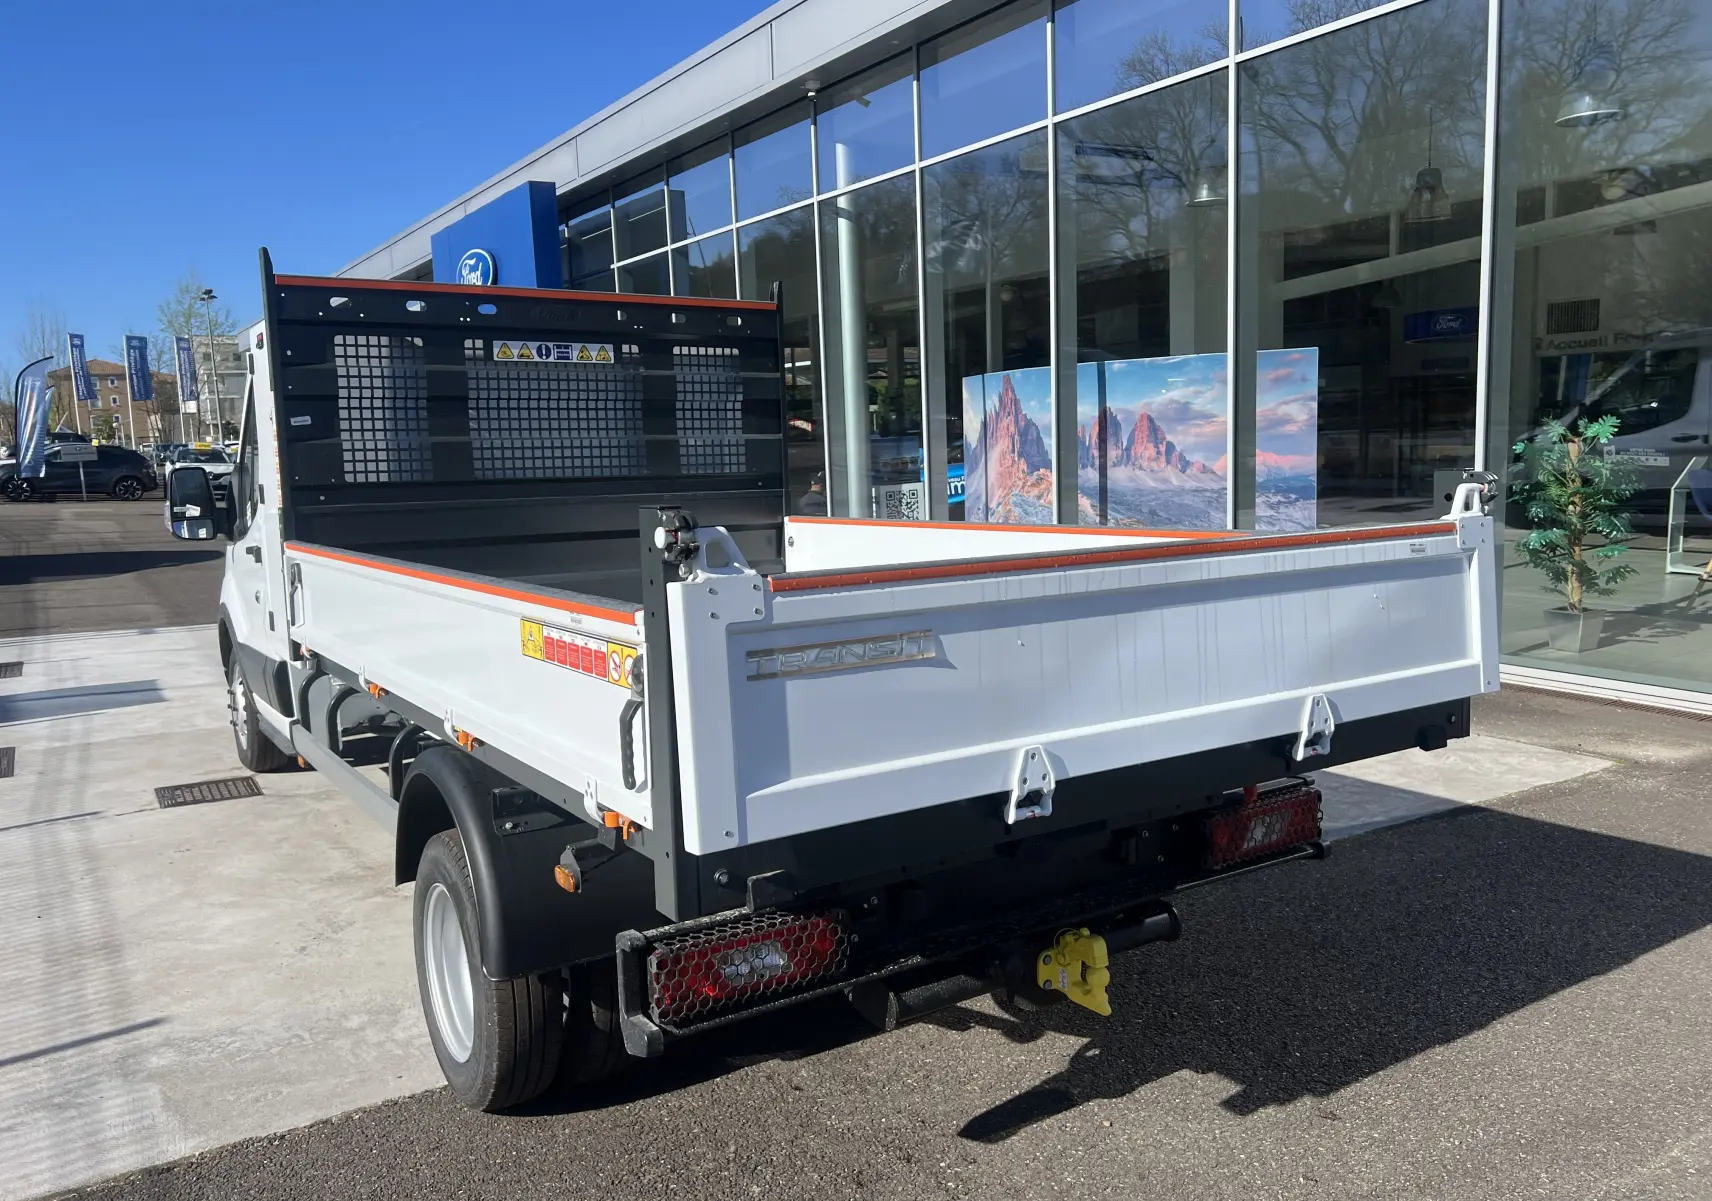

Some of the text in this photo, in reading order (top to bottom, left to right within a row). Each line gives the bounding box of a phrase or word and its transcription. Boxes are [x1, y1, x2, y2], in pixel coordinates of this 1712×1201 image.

[460, 257, 483, 286] Ford
[1436, 316, 1462, 330] Ford
[746, 637, 933, 676] TRANSIT
